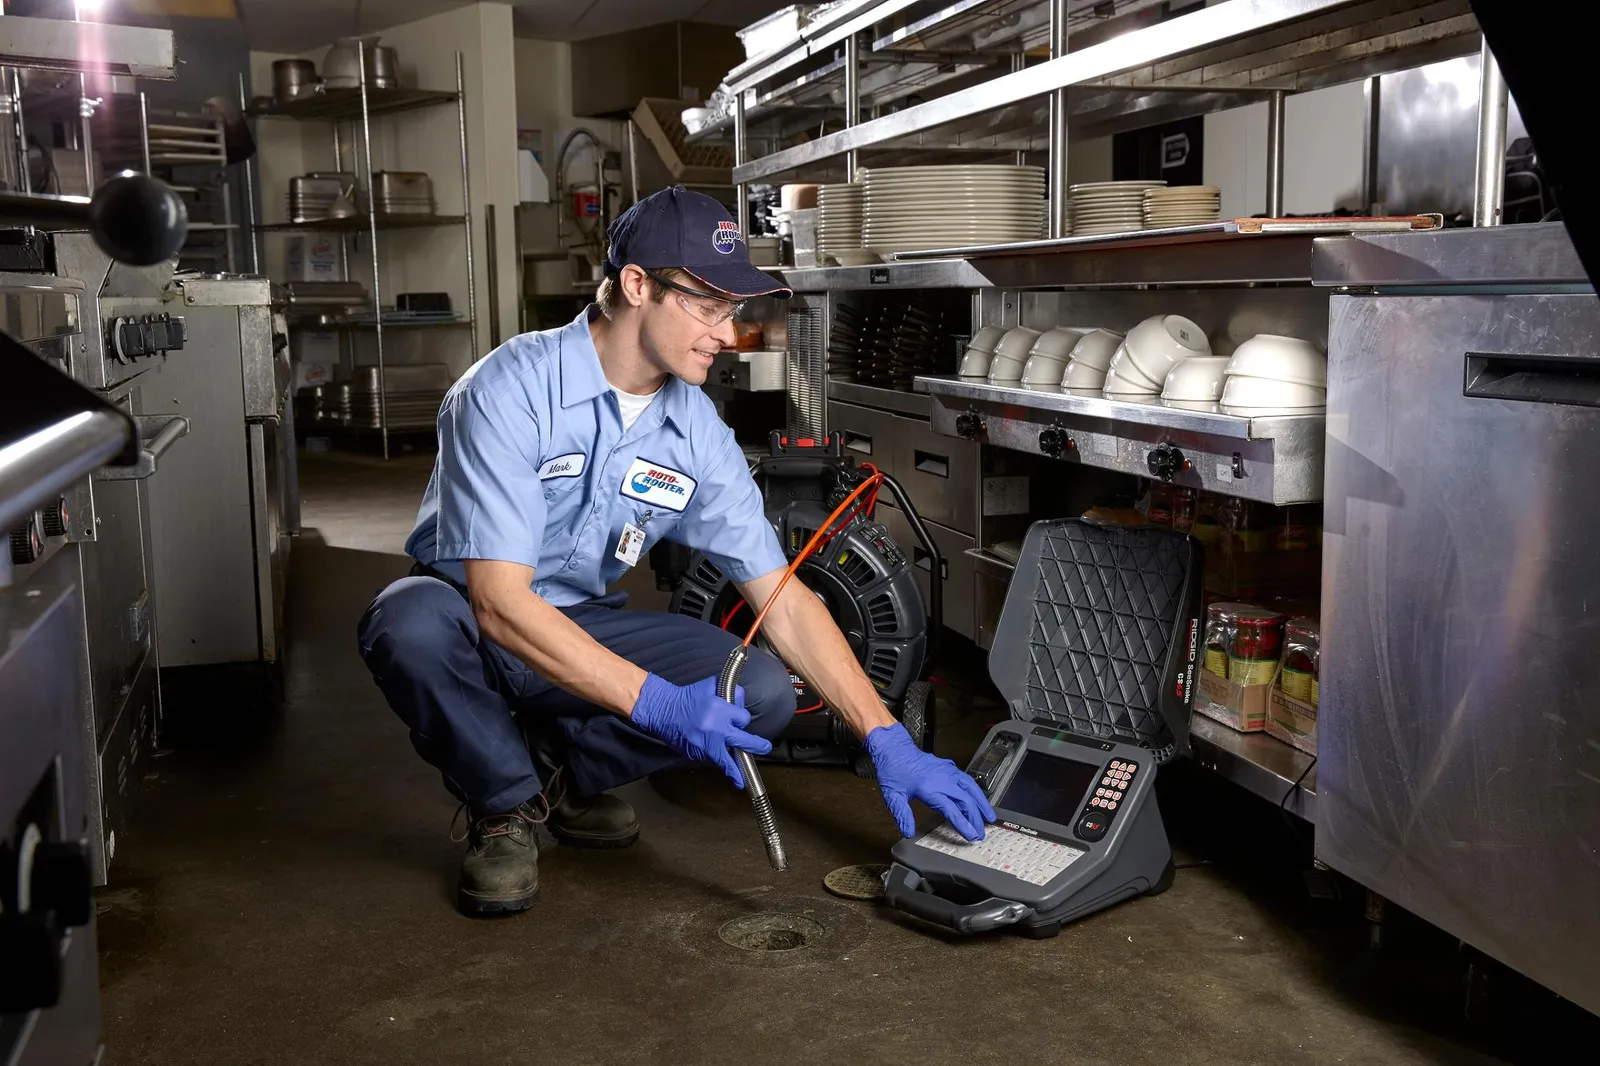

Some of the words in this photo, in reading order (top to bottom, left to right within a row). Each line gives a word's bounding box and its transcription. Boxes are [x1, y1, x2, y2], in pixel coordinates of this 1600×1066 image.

[546, 461, 572, 475] Mark
[647, 469, 679, 484] ROTO-
[1189, 618, 1198, 662] RIDGID
[1184, 664, 1193, 704] SeeSnake
